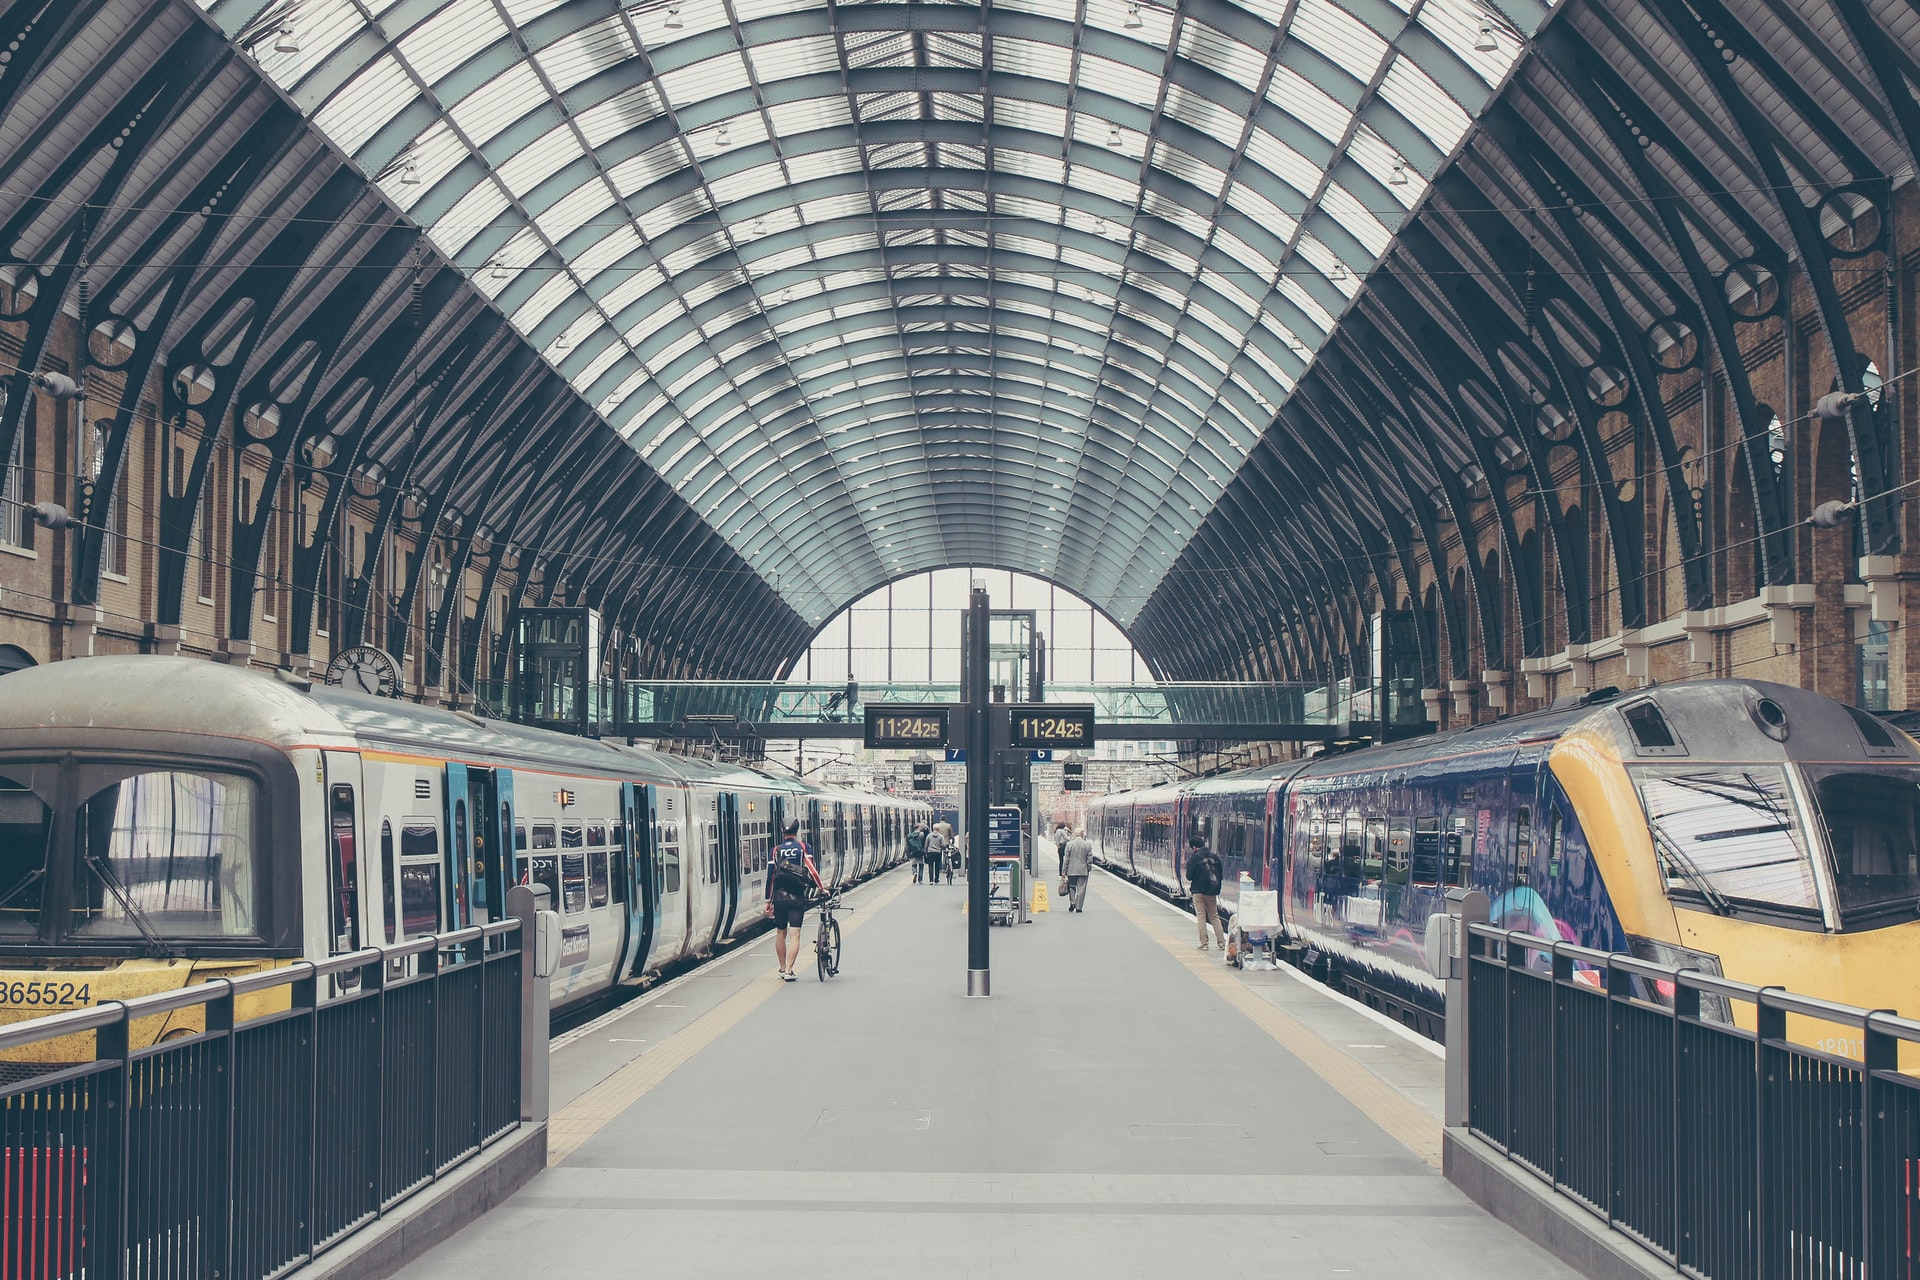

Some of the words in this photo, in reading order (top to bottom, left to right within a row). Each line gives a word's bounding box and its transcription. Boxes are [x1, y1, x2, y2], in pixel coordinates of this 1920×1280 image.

[951, 748, 960, 759] 7
[1037, 749, 1046, 759] 6
[780, 848, 798, 857] TCC
[563, 937, 573, 956] Great
[572, 935, 588, 953] Northern
